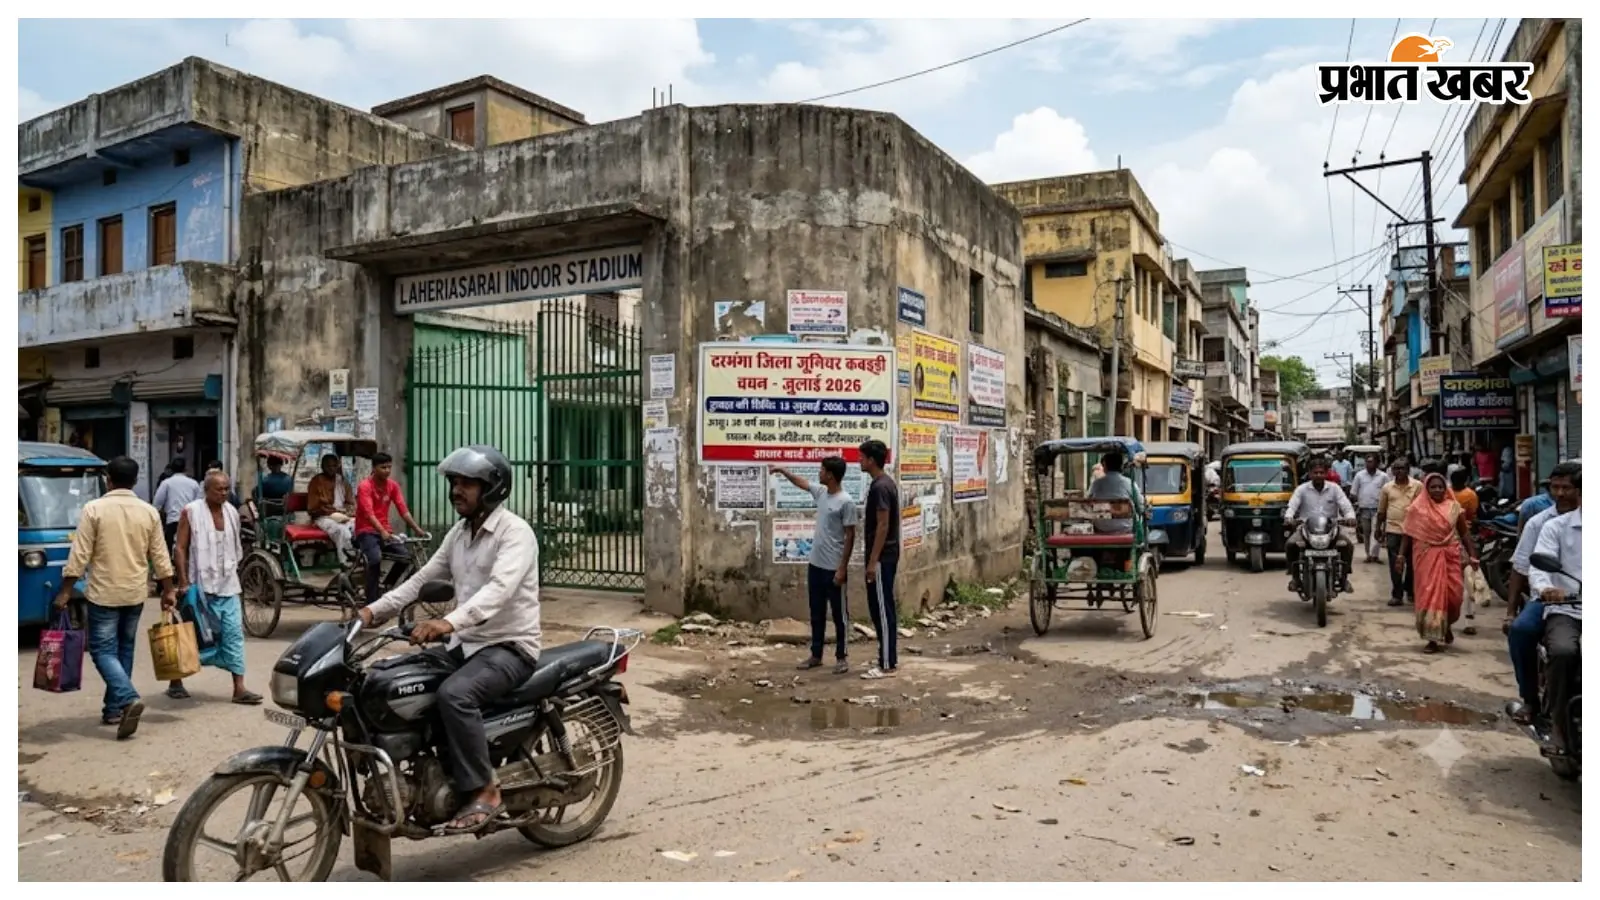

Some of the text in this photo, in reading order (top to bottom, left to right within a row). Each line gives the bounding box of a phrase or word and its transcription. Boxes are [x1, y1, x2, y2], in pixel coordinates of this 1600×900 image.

[400, 252, 642, 305] LAHERIASARAI INDOOR STADIUM
[757, 352, 793, 369] जिला
[825, 378, 862, 392] 2026
